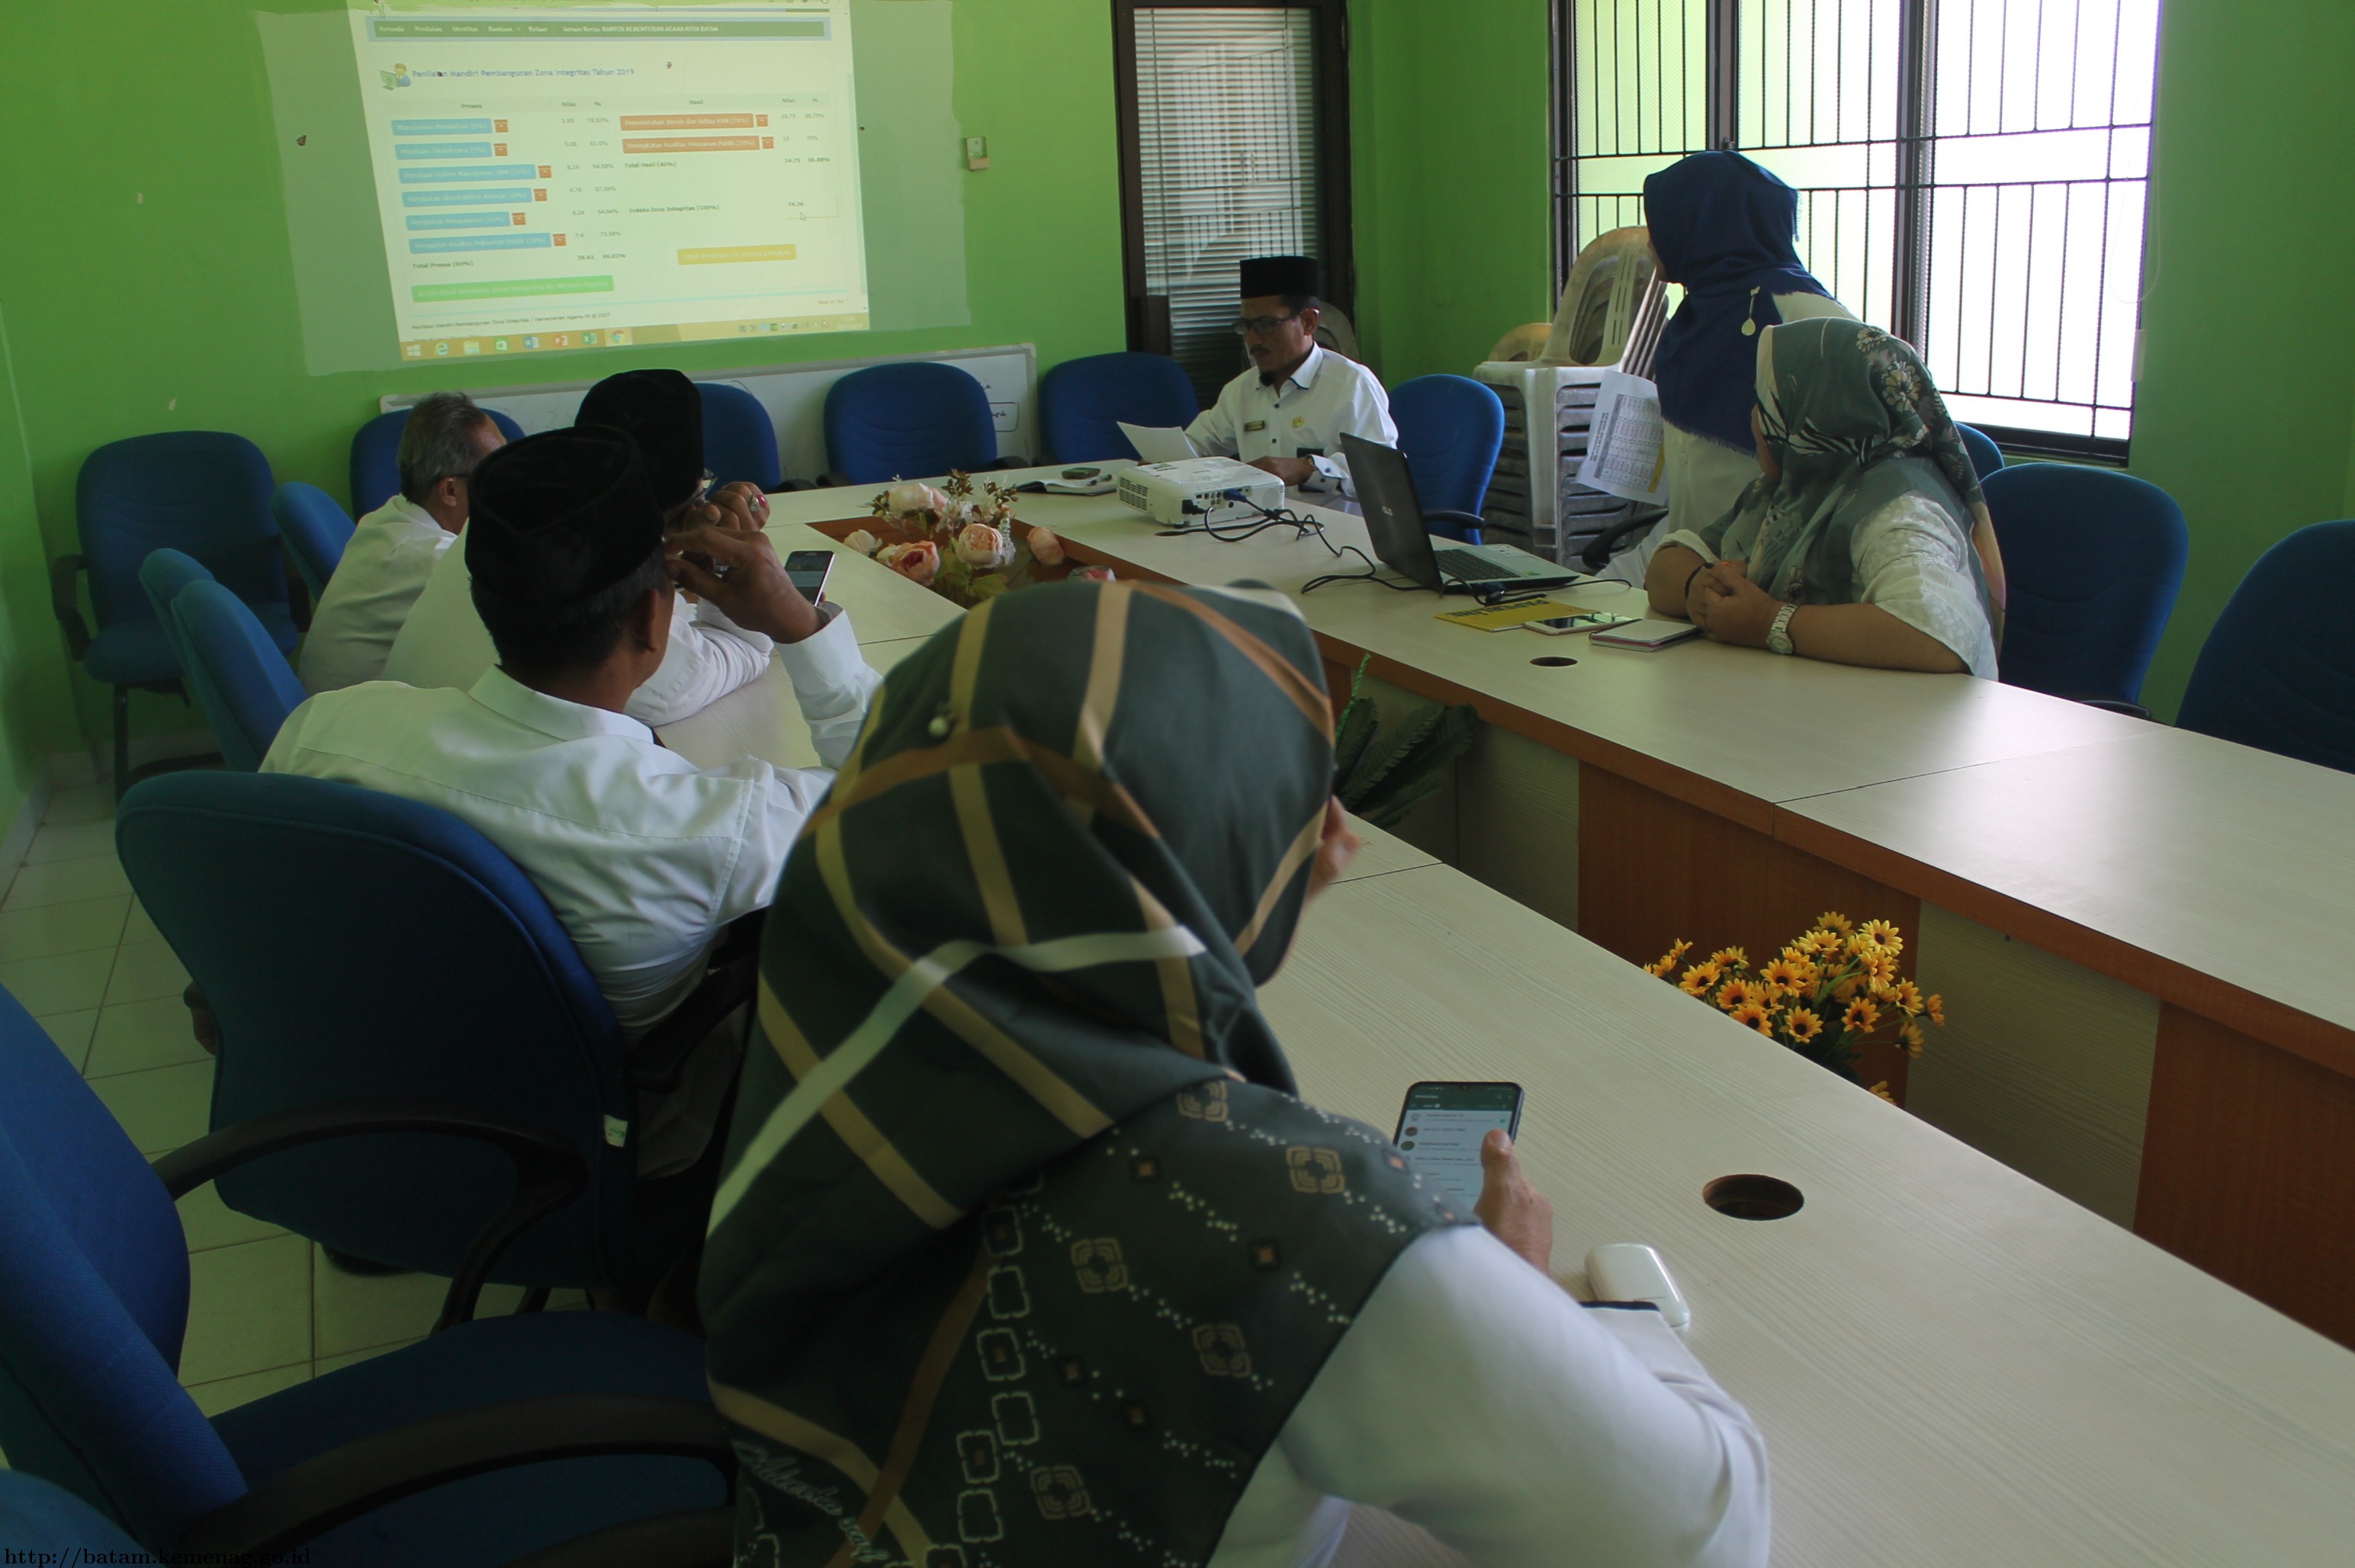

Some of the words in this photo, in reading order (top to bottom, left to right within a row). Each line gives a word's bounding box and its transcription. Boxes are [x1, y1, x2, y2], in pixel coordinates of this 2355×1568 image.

[481, 69, 533, 78] Pembangunan
[555, 69, 590, 78] Integritas
[1446, 599, 1551, 617] PAPERLINE
